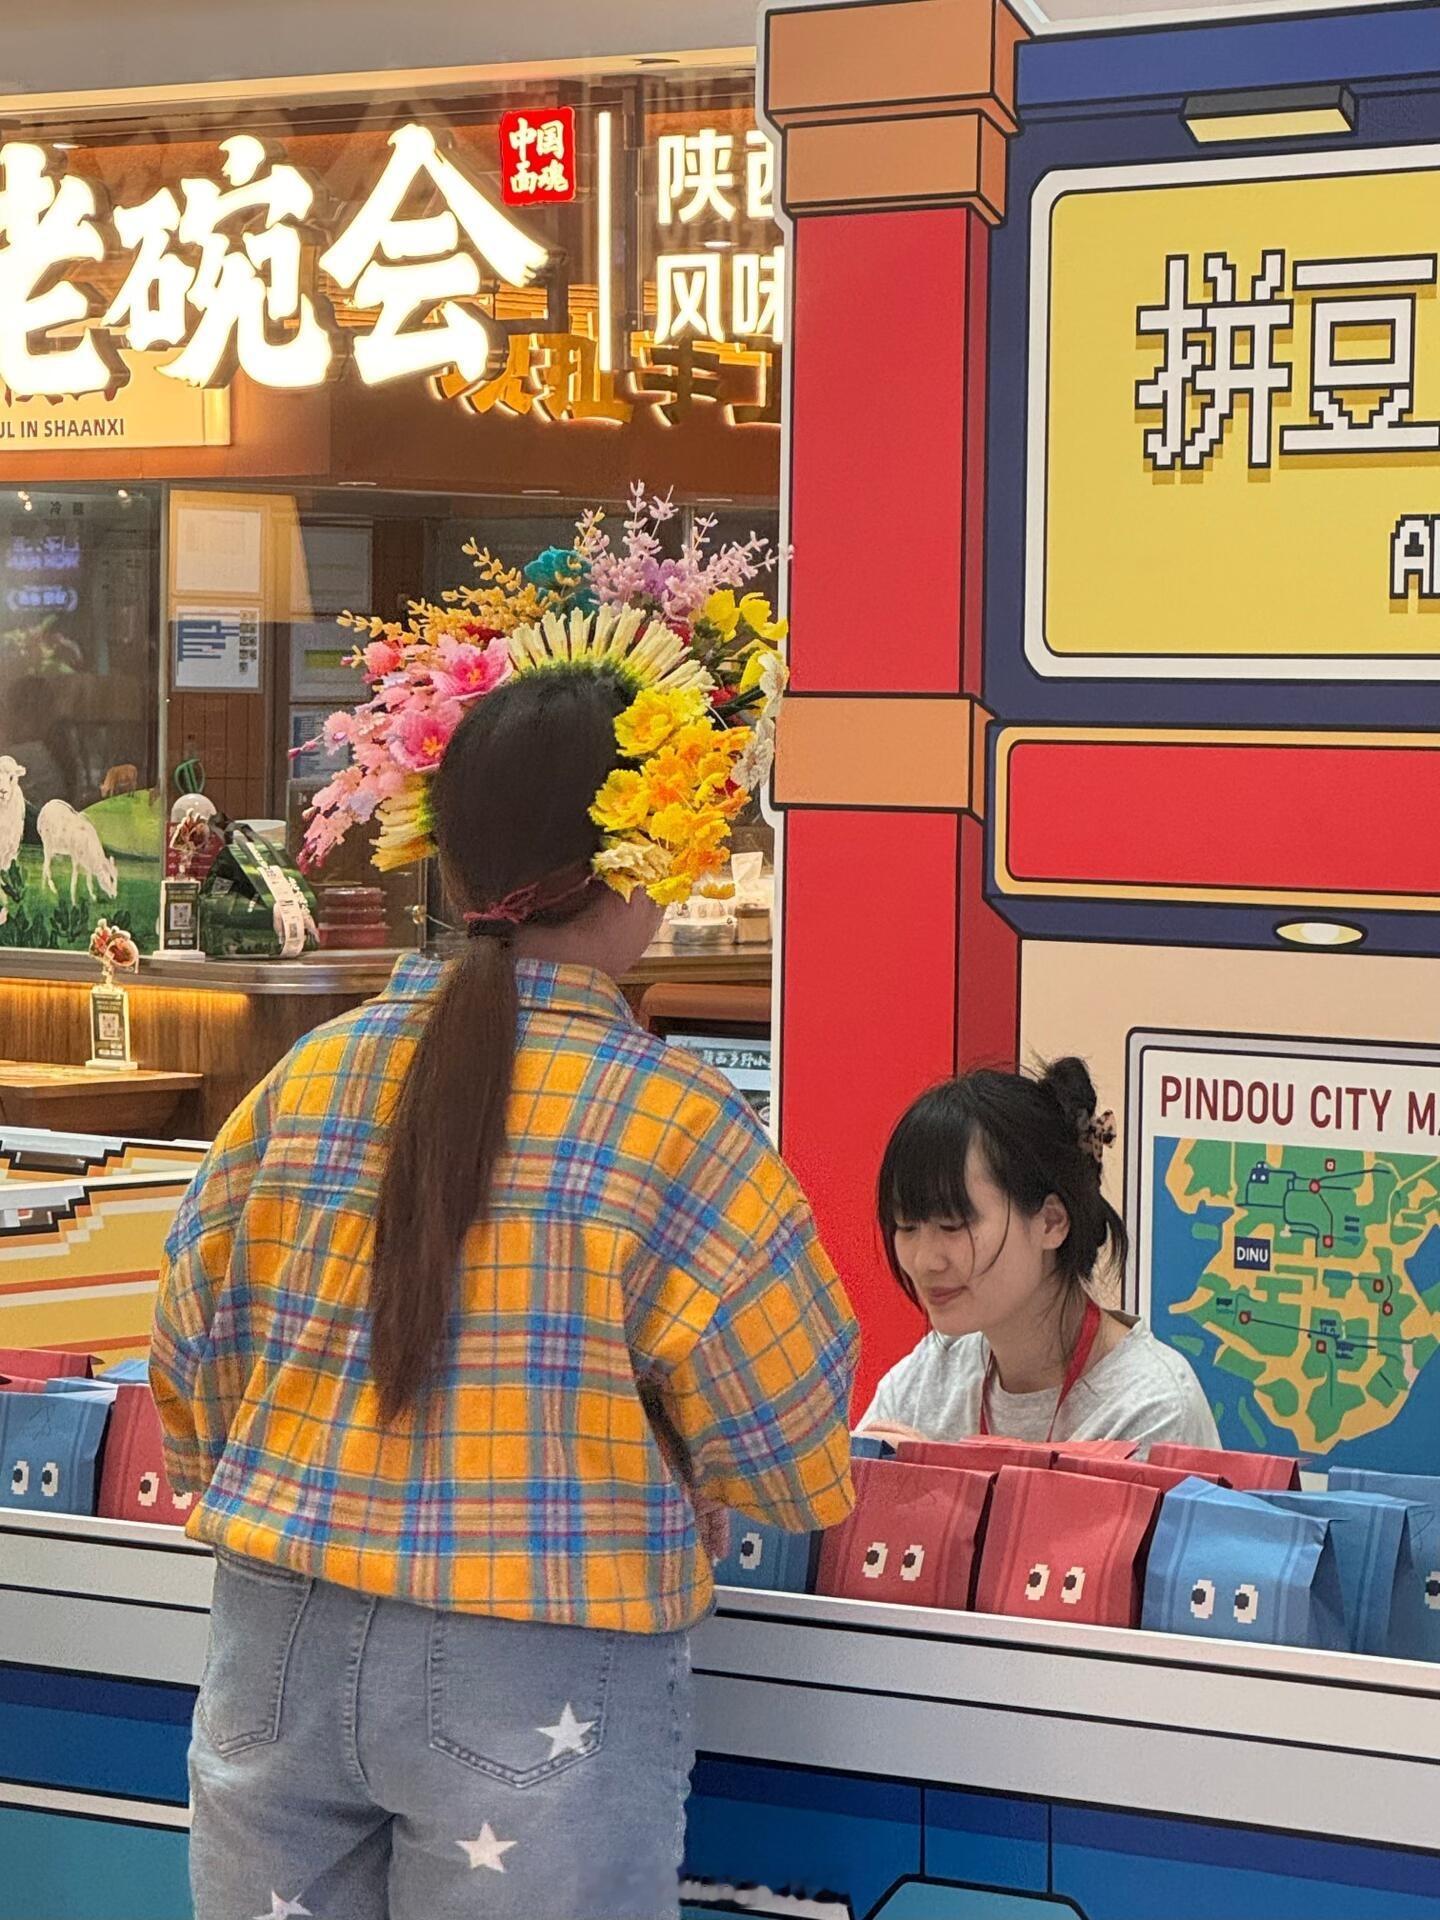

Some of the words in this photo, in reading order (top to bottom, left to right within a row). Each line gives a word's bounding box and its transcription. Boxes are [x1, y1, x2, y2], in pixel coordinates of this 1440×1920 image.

[509, 117, 564, 161] 中国
[0, 124, 549, 394] 老碗会
[654, 246, 784, 344] 风味
[1136, 249, 1440, 470] 拼豆
[21, 421, 38, 437] IN
[44, 418, 125, 437] SHAANXI
[1161, 1075, 1294, 1126] PINDOU
[1310, 1085, 1392, 1132] CITY
[1408, 1091, 1440, 1137] M
[1236, 1246, 1269, 1263] DINU
